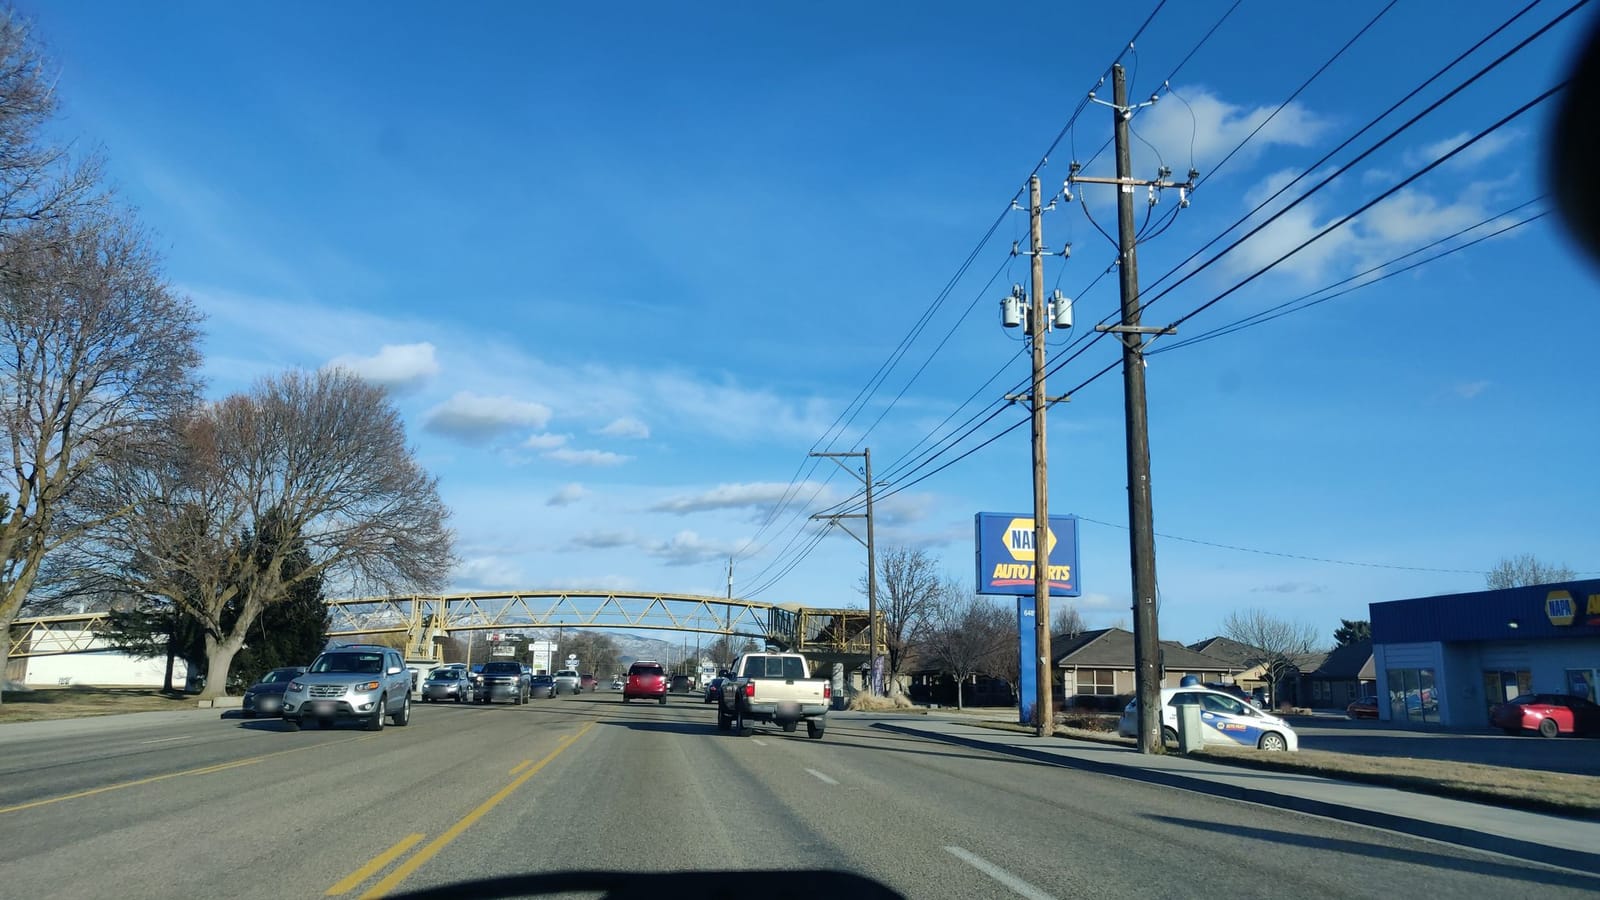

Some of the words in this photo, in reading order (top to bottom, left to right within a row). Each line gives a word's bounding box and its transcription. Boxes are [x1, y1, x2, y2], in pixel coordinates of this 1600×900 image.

[1012, 530, 1037, 549] NA
[993, 564, 1029, 579] AUTO
[1030, 565, 1071, 581] RTS
[1549, 599, 1572, 616] NAPA
